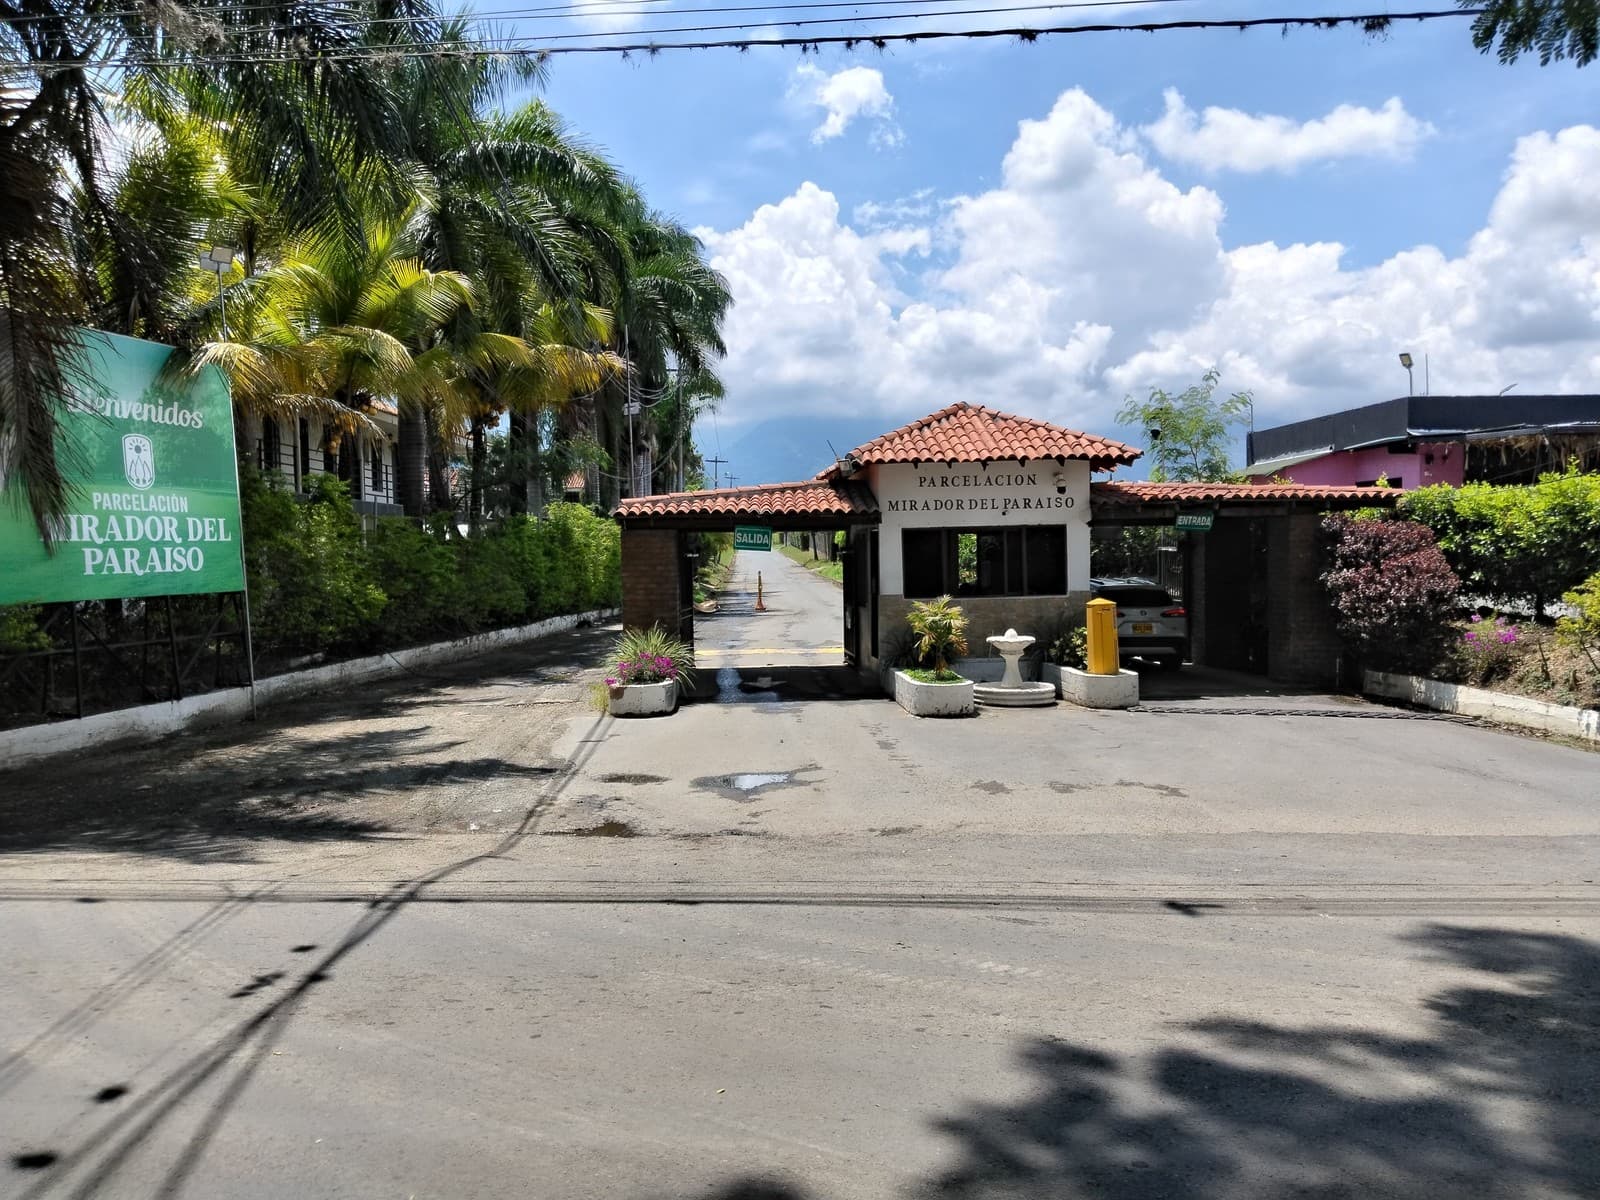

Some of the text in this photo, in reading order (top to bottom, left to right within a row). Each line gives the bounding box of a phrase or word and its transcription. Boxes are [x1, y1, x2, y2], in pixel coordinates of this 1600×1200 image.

[918, 474, 1037, 487] PARCELACION
[92, 492, 188, 513] PARCELACIÓN
[888, 497, 1075, 511] MIRADOR DEL PARAISO
[1177, 515, 1211, 526] ENTRADA
[187, 517, 231, 541] DEL
[736, 533, 769, 544] SALIDA
[83, 546, 204, 575] PARAISO
